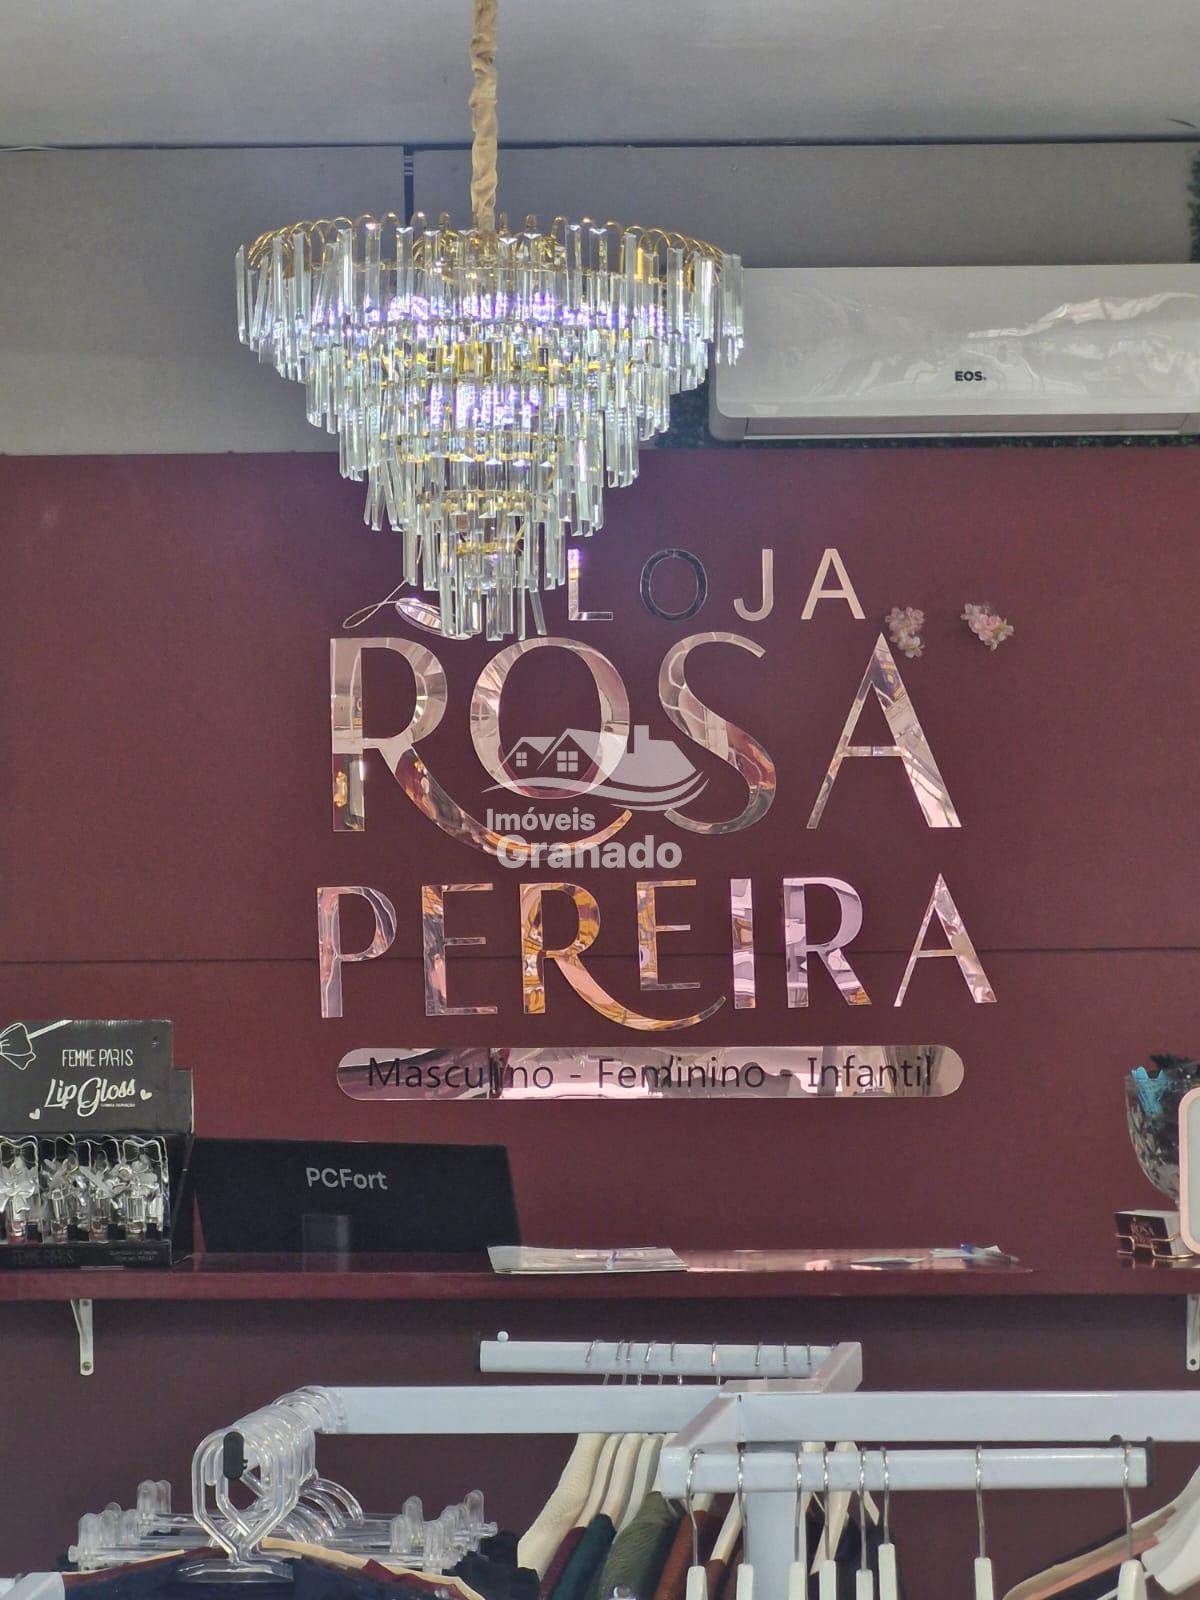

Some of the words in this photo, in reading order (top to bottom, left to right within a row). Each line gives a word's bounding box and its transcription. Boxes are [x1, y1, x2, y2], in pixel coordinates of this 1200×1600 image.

[567, 546, 866, 623] LOJA
[329, 631, 963, 858] ROSA
[315, 872, 998, 1032] PEREIRA
[62, 1049, 96, 1067] FEMME
[100, 1048, 134, 1067] PARIS
[368, 1056, 554, 1089] Masculino
[598, 1055, 766, 1089] Feminino
[808, 1054, 934, 1088] Infantil
[44, 1077, 76, 1110] Lip
[77, 1076, 136, 1117] Gloss
[305, 1167, 389, 1191] PCFort
